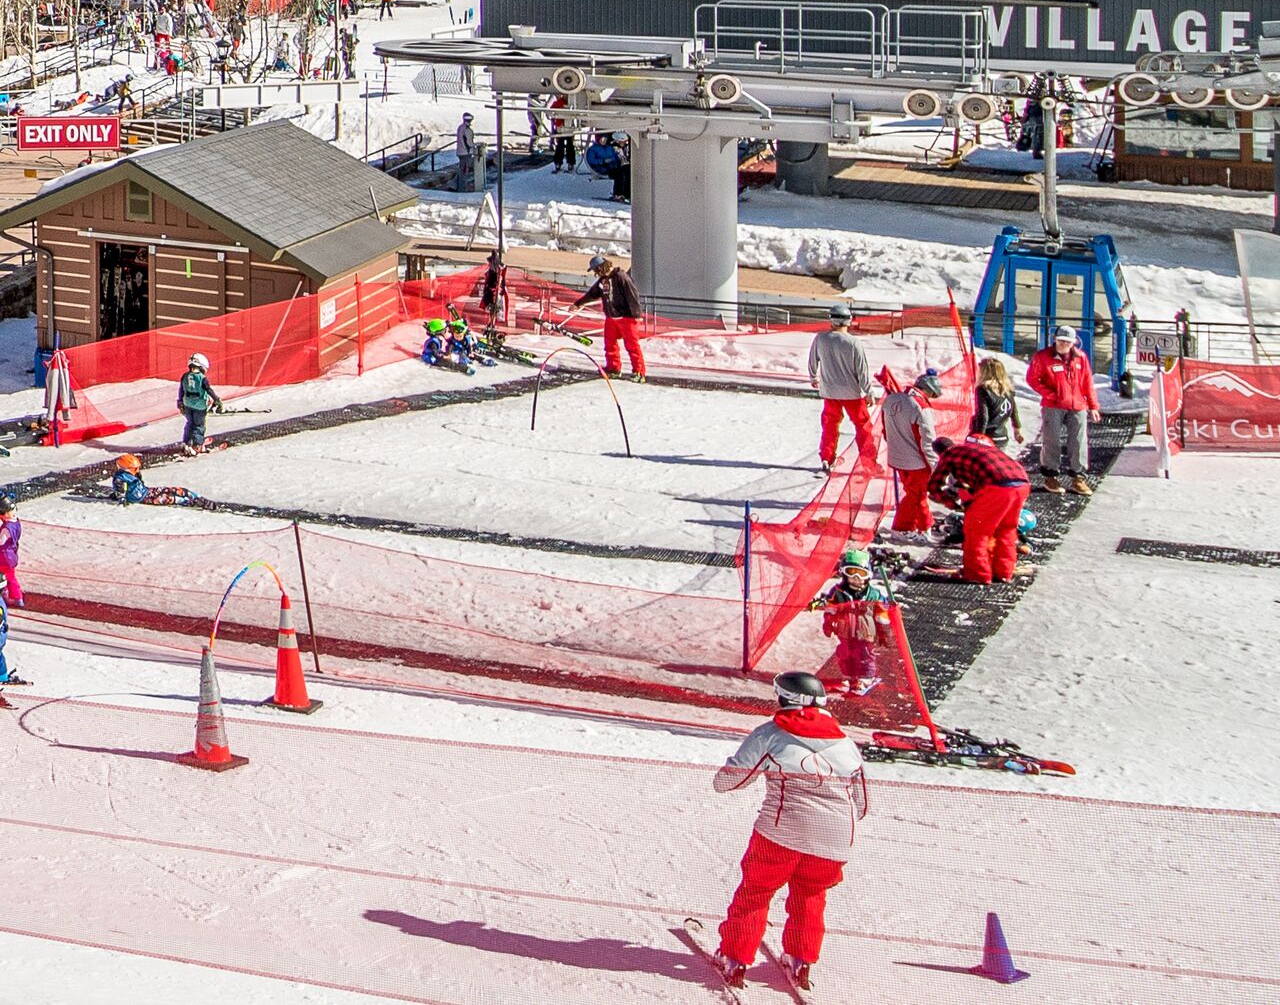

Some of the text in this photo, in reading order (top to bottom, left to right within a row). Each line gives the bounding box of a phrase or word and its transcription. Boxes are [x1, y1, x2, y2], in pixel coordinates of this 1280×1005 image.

[983, 5, 1252, 53] VILLAGE
[25, 124, 113, 143] EXIT ONLY
[1175, 419, 1218, 439] Ski
[1231, 419, 1280, 439] Cu
